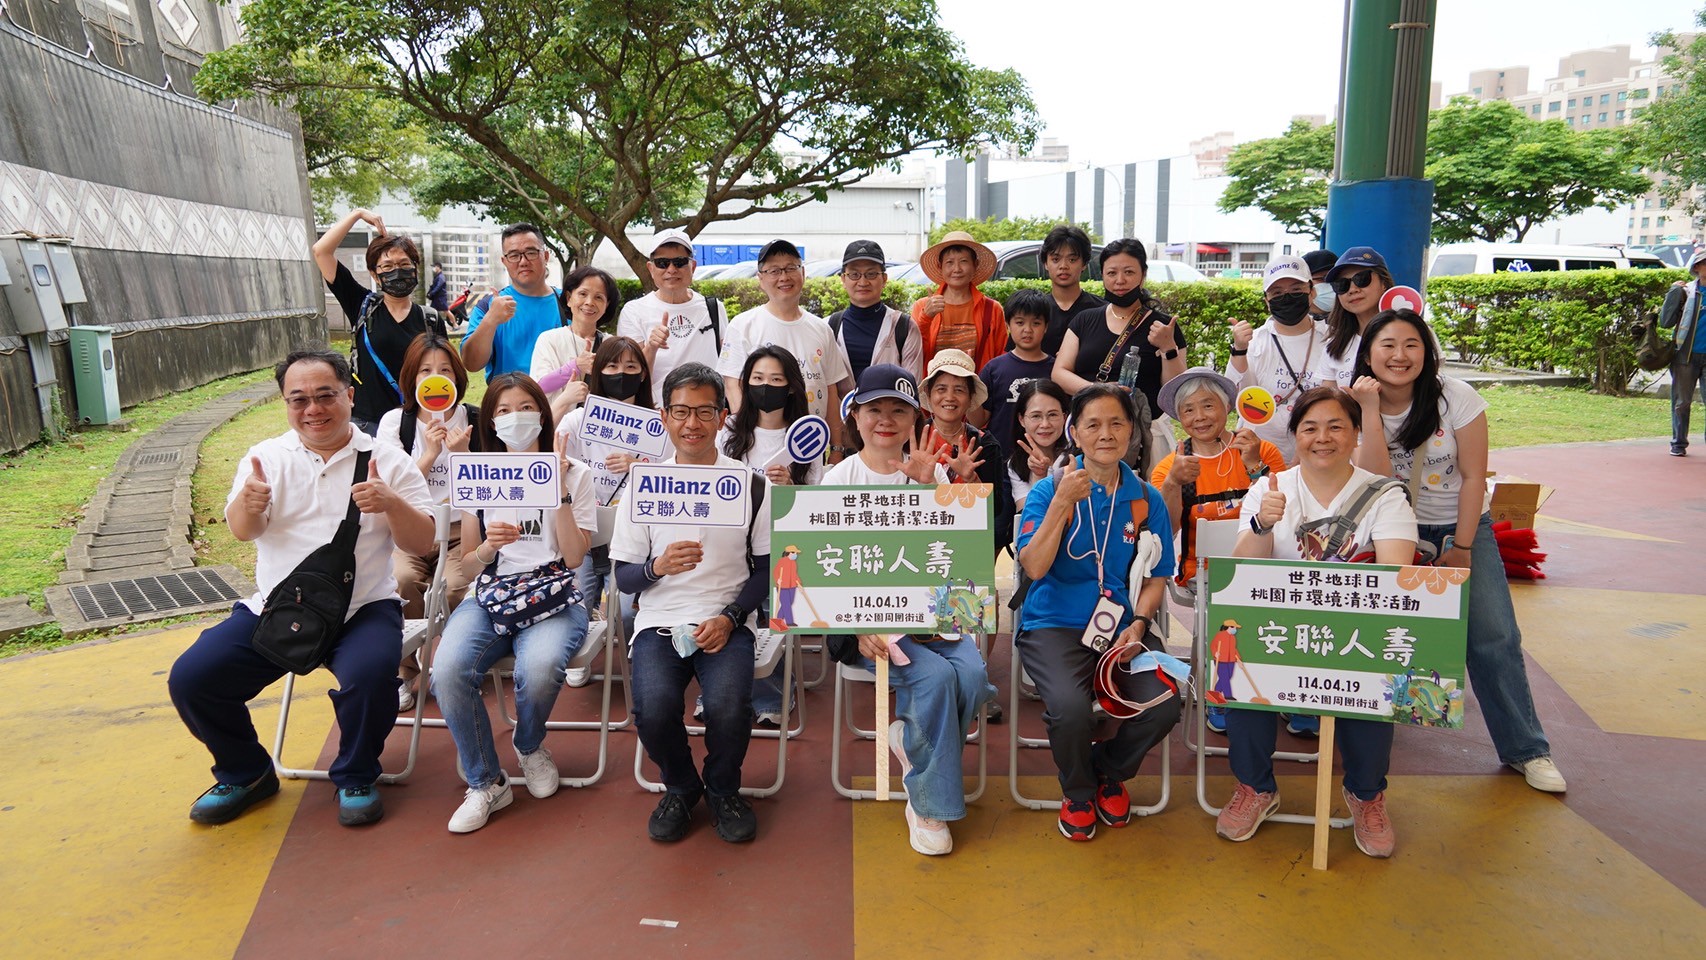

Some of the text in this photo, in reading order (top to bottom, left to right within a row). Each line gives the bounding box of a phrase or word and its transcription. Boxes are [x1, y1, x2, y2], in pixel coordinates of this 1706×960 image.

[1269, 262, 1291, 275] Allianz
[1276, 380, 1291, 389] for
[588, 405, 643, 430] Allianz
[584, 422, 639, 446] 安聯人壽
[429, 464, 449, 475] ady
[457, 464, 524, 480] Allianz
[428, 478, 446, 487] the
[600, 476, 618, 486] the
[638, 475, 711, 495] Allianz
[457, 486, 525, 501] 安聯人壽
[842, 493, 920, 507] 世界地球日
[636, 500, 710, 518] 安聯人壽
[809, 510, 955, 527] 桃園市環境清潔活動
[816, 540, 954, 578] 安聯人壽
[1288, 570, 1379, 588] 世界地球日
[853, 596, 908, 608] 114.04.19
[1250, 587, 1420, 612] 桃園市環境清潔活動
[1257, 620, 1417, 667] 安聯人壽
[1298, 676, 1361, 693] 114.04.19
